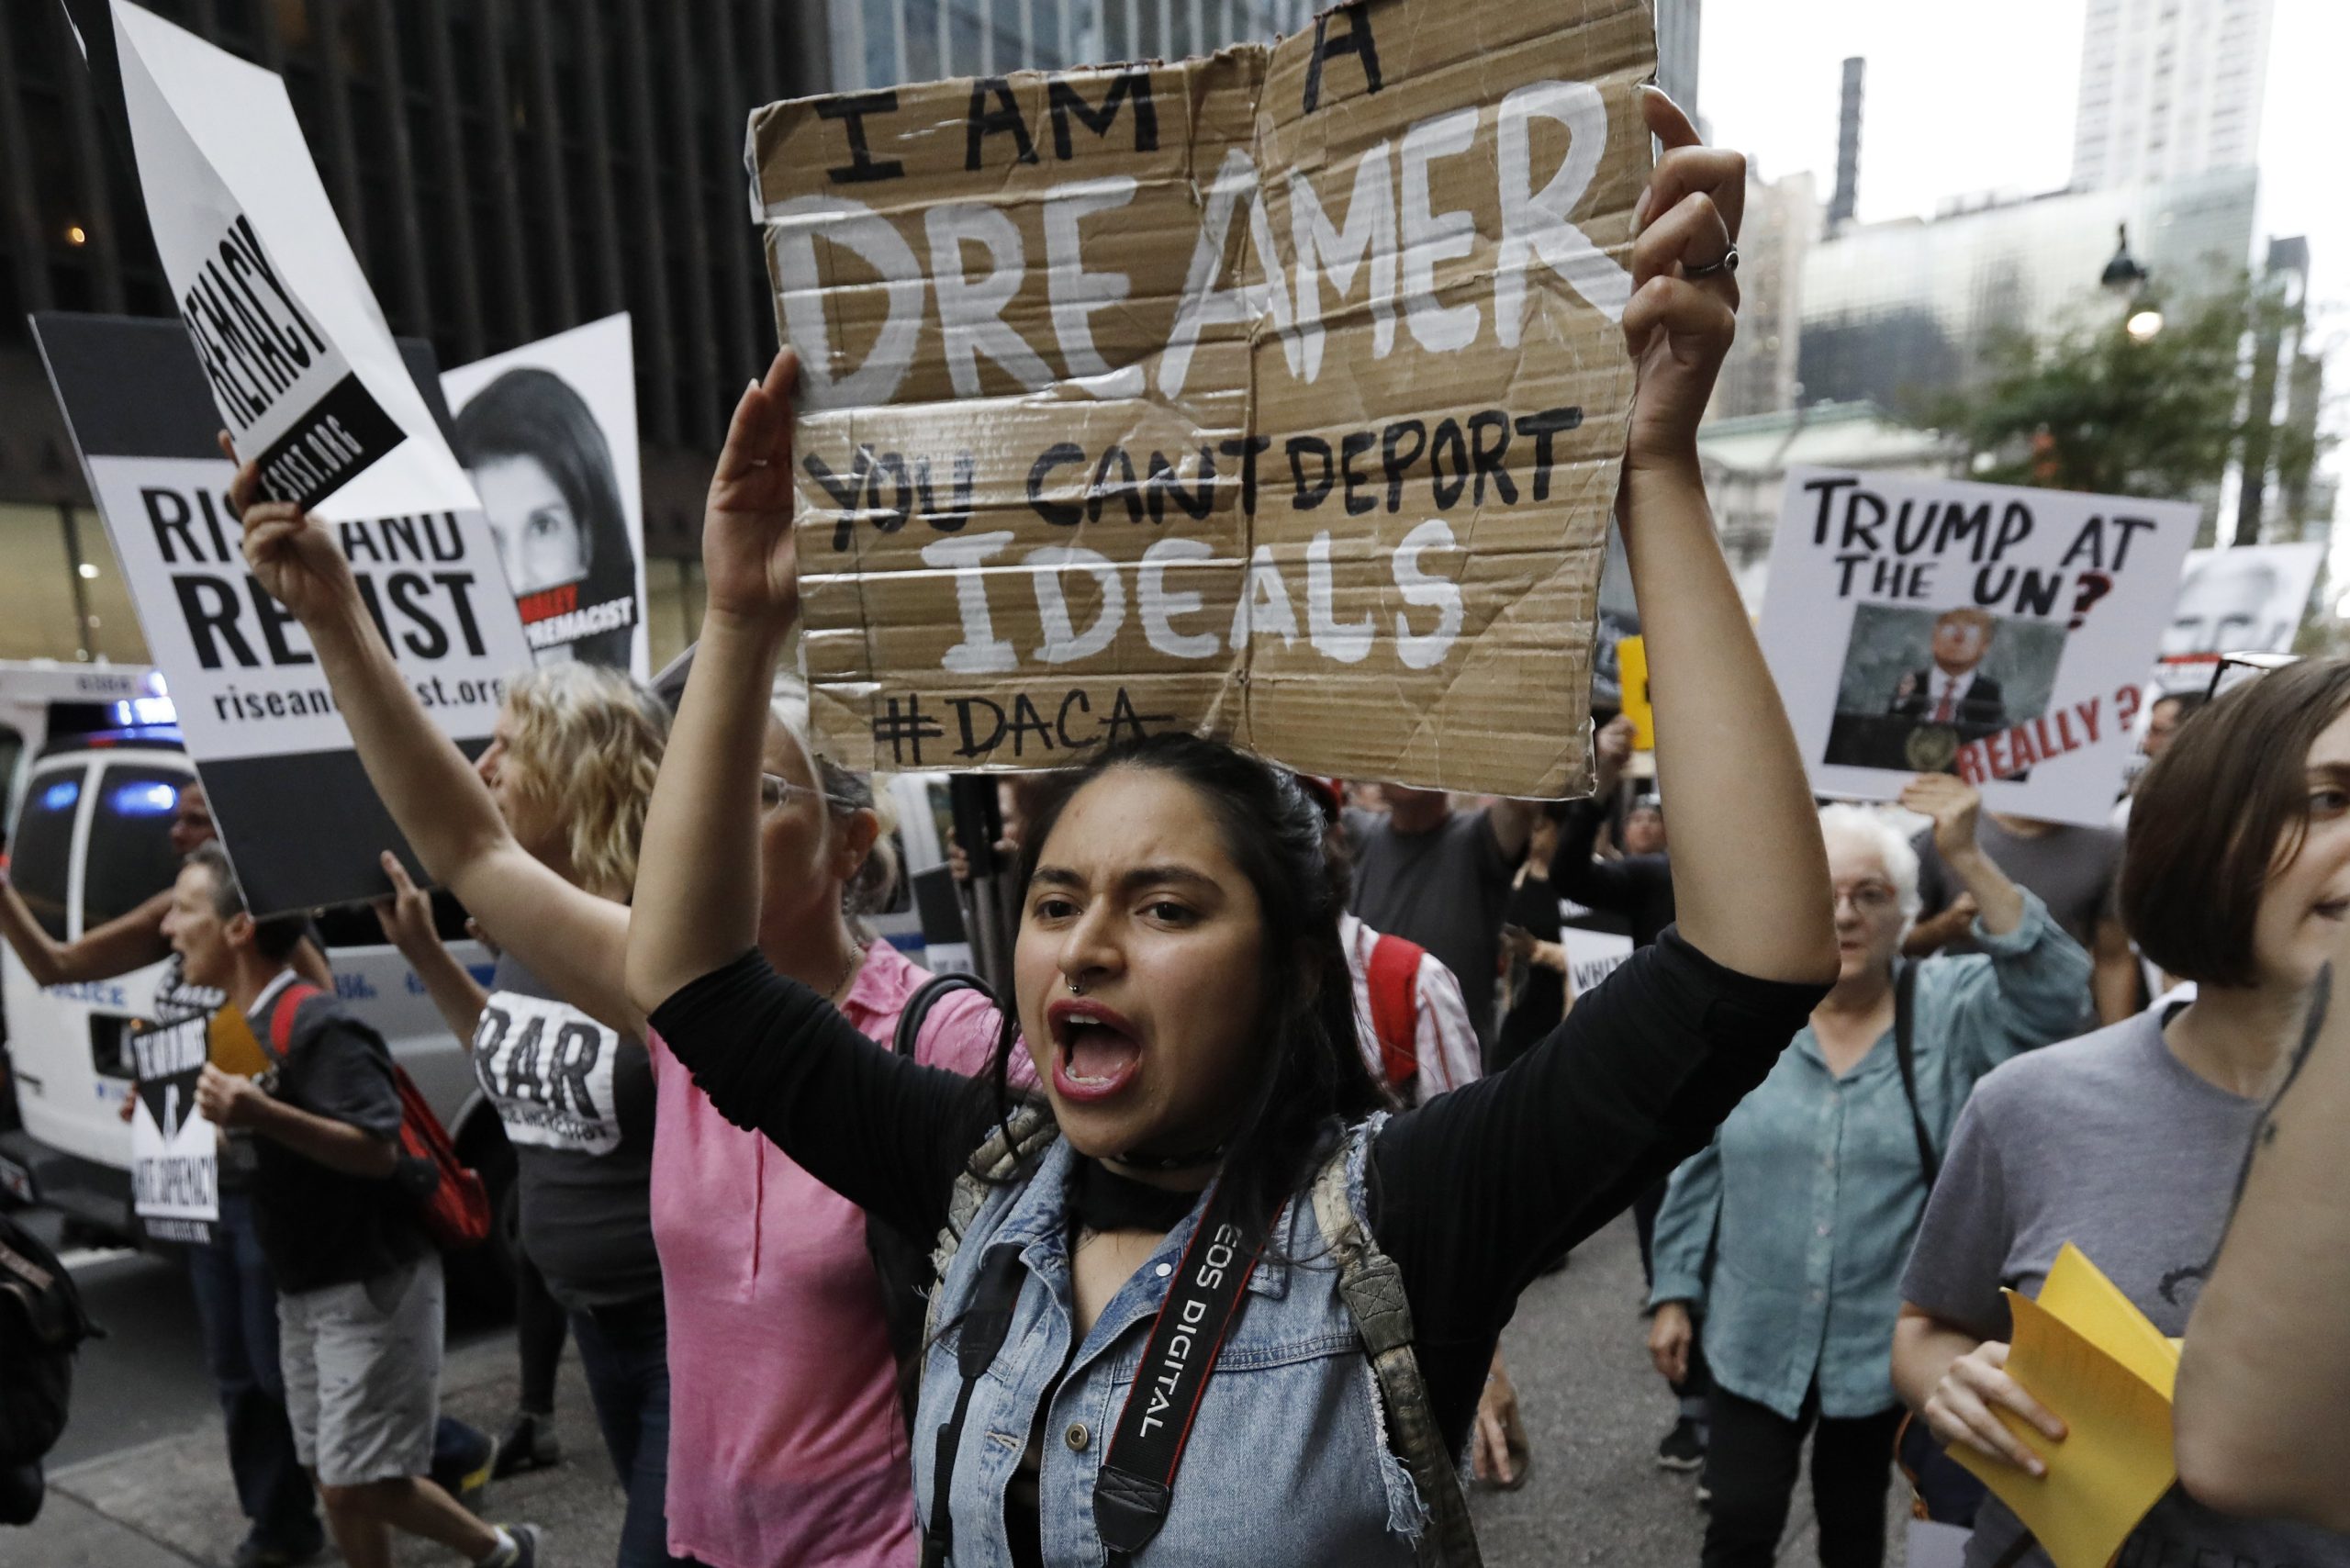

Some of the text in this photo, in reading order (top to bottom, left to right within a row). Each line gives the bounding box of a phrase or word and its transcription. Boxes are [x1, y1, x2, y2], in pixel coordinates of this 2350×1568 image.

[814, 2, 1382, 182] I AM A
[774, 79, 1633, 410] DREAMER
[804, 407, 1584, 551] YOU CANT DEPORT
[1804, 477, 2157, 571] TRUMP AT
[171, 571, 487, 668] REIST
[921, 520, 1465, 673] IDEALS
[1834, 554, 2113, 630] THE UN?
[873, 689, 1174, 761] #DACA
[1955, 696, 2101, 787] REALLY
[1140, 1223, 1242, 1438] EOS DIGITAL
